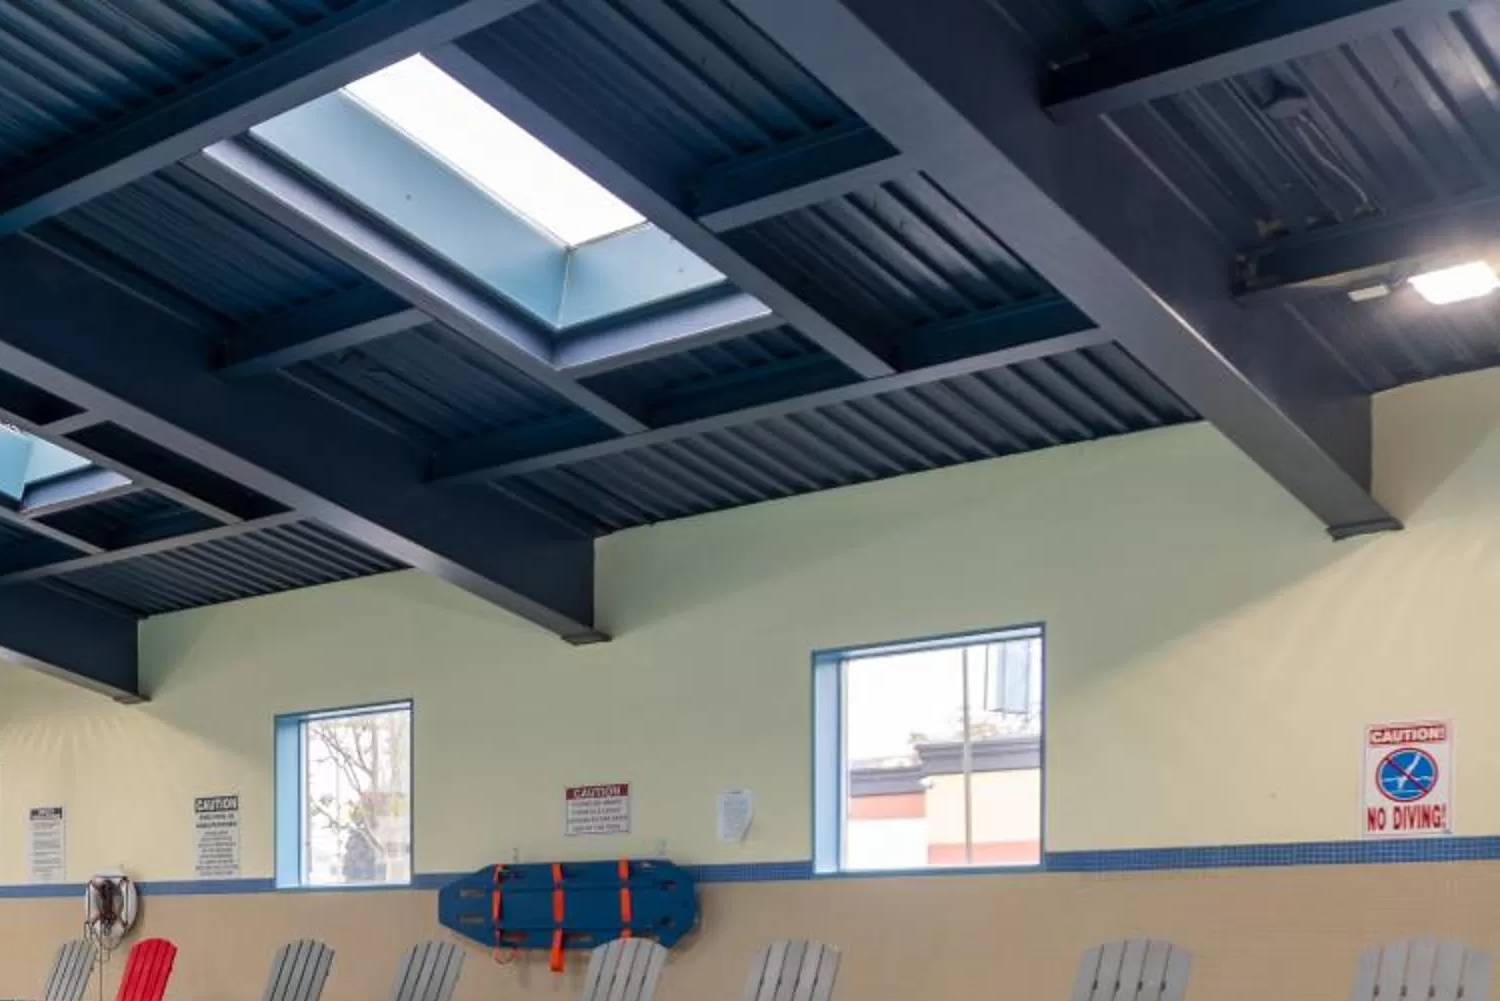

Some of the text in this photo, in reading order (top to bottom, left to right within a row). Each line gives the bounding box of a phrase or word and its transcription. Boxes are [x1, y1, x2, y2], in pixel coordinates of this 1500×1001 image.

[1371, 726, 1445, 743] CAUTION!
[574, 785, 621, 799] CAUTION
[197, 799, 237, 810] CAUTION
[1367, 804, 1446, 831] NO DIVING!
